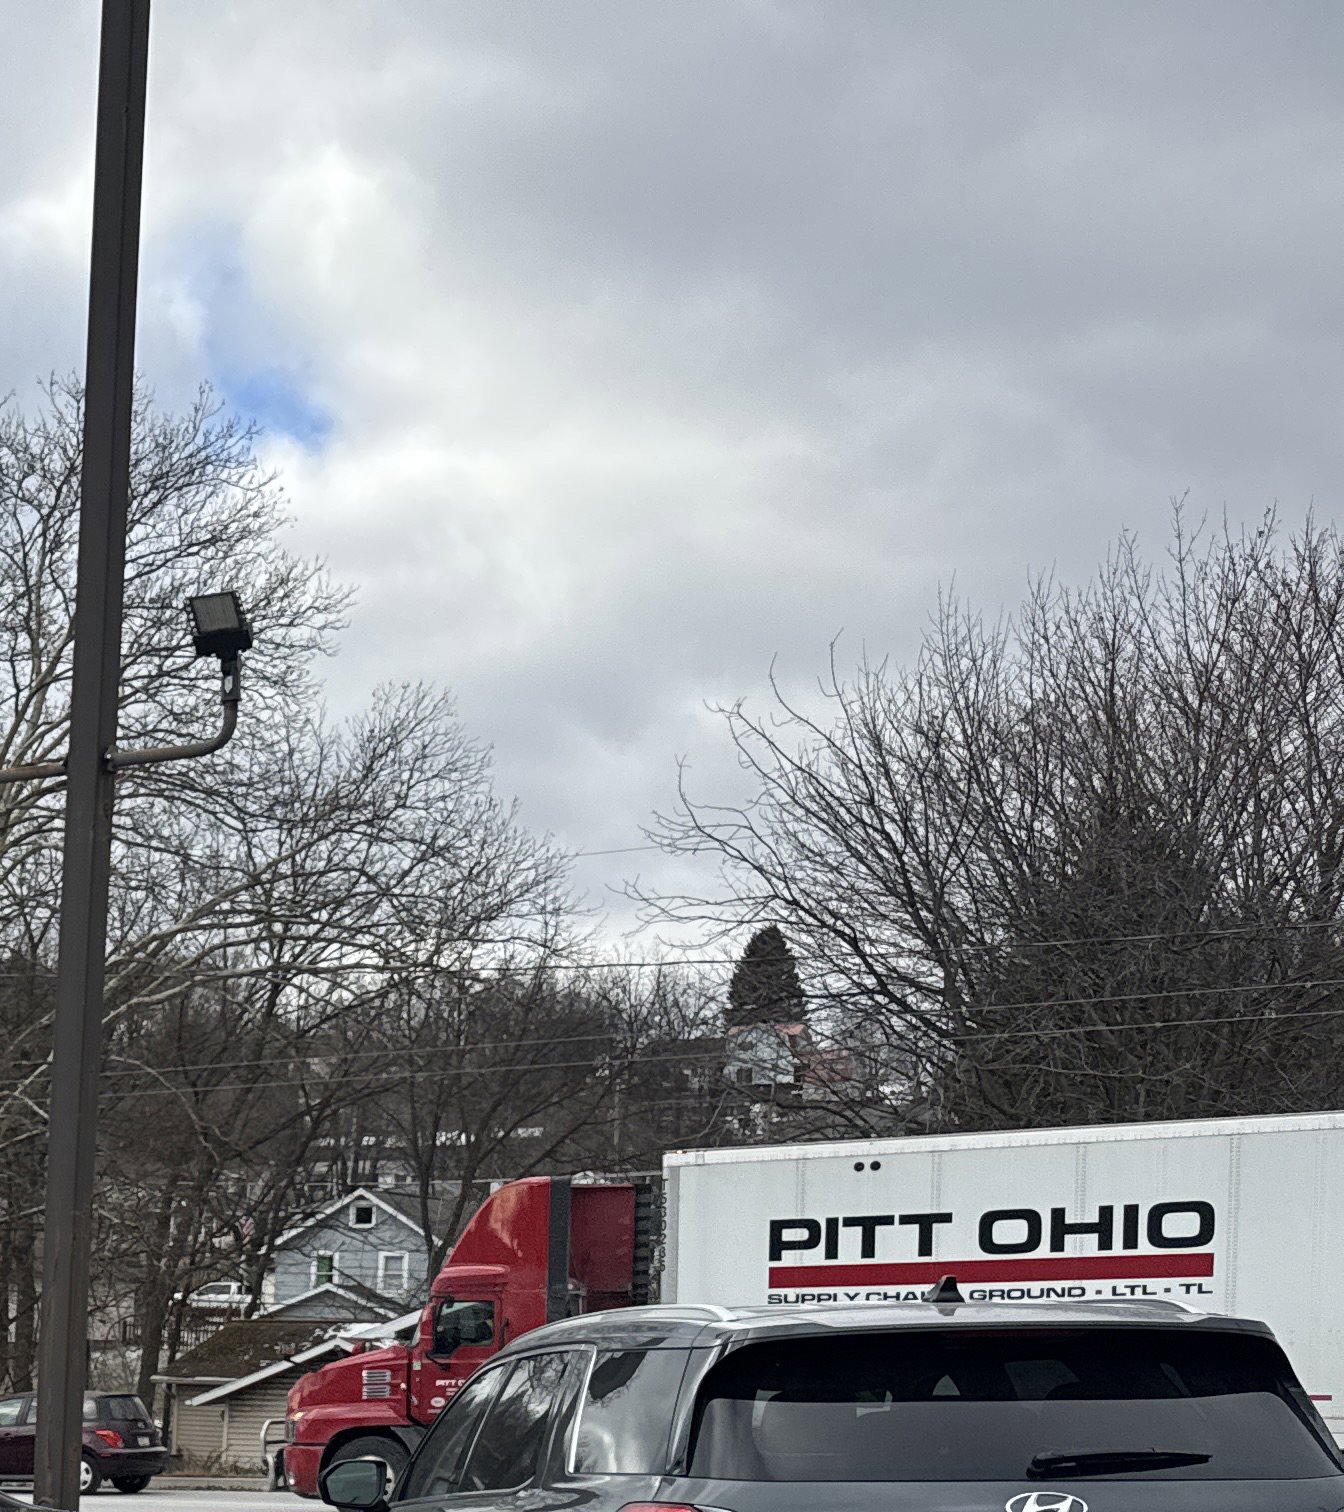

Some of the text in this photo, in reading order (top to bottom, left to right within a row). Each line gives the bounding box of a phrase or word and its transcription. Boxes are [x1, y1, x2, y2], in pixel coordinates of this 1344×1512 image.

[768, 1200, 1216, 1261] PITT OHIO
[969, 1286, 1086, 1301] GROUND
[1112, 1284, 1157, 1297] LTL
[1179, 1282, 1214, 1294] TL
